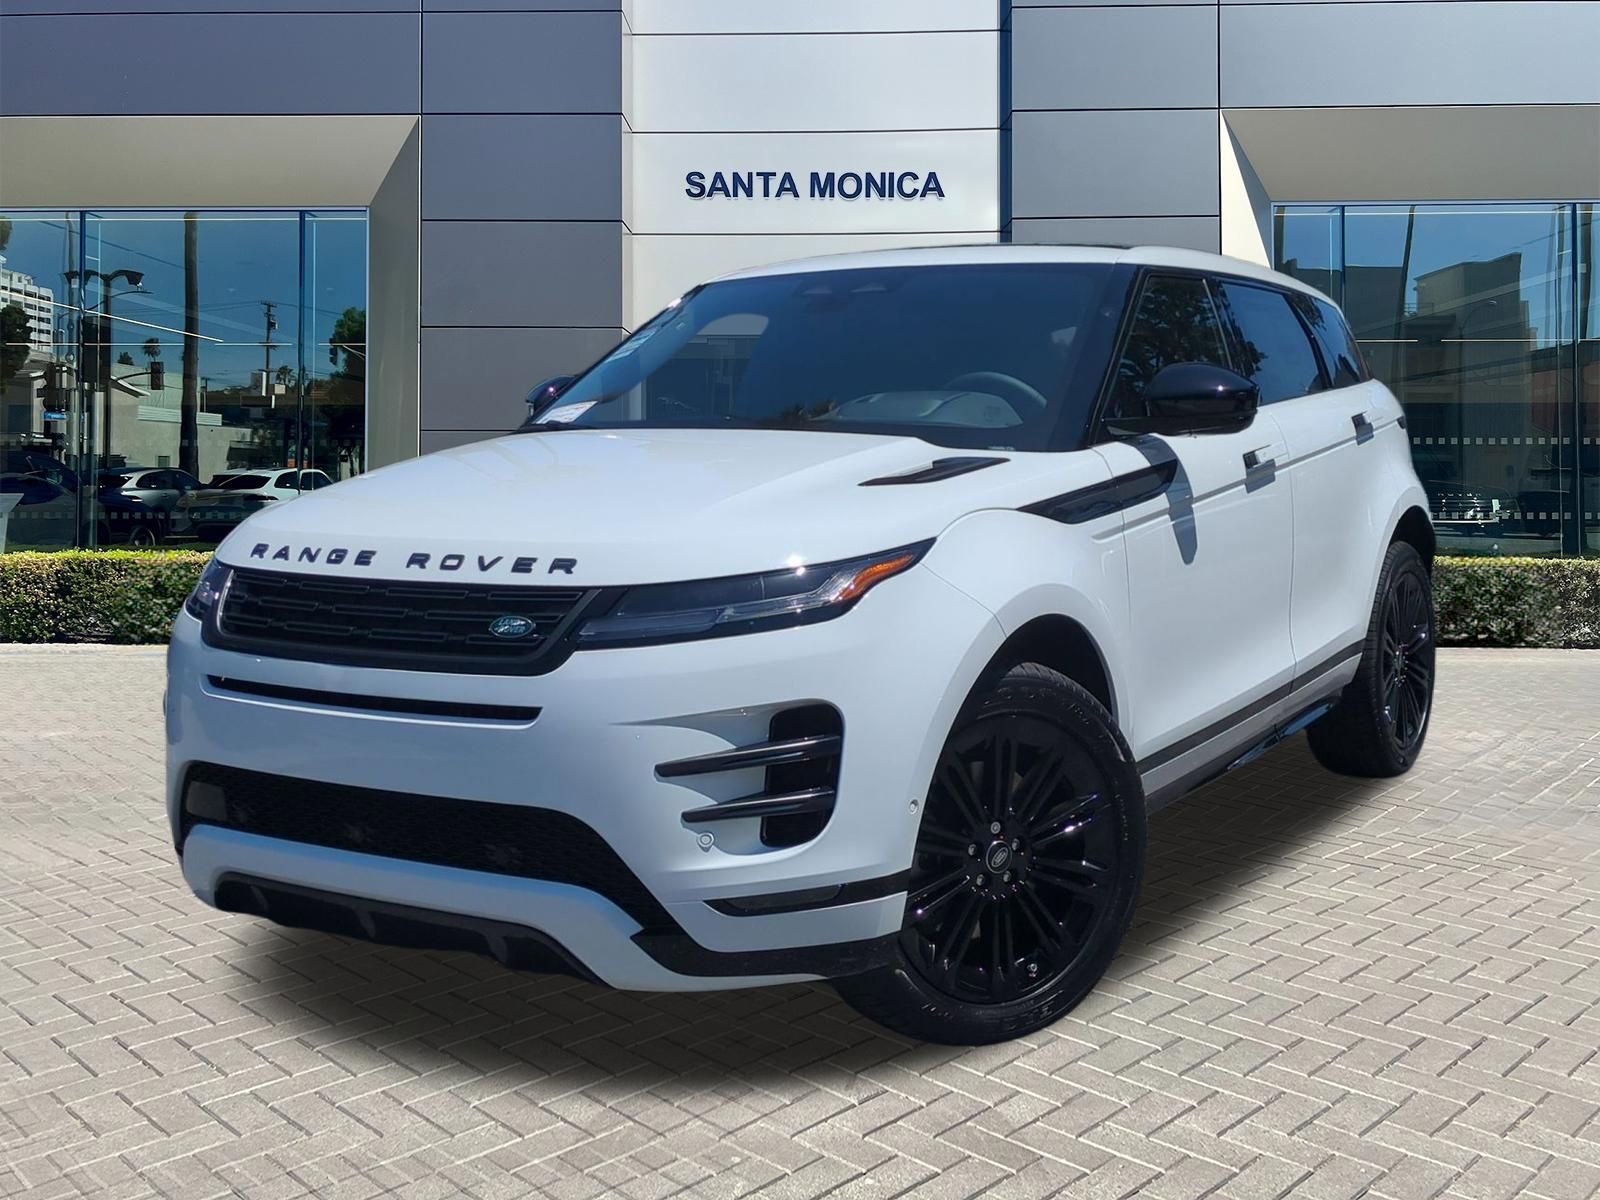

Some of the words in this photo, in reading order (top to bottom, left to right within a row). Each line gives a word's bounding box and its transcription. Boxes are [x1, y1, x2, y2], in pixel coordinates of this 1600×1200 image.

[685, 171, 800, 199] SANTA
[809, 171, 945, 199] MONICA
[250, 543, 377, 567] RANGE
[405, 552, 578, 575] ROVER
